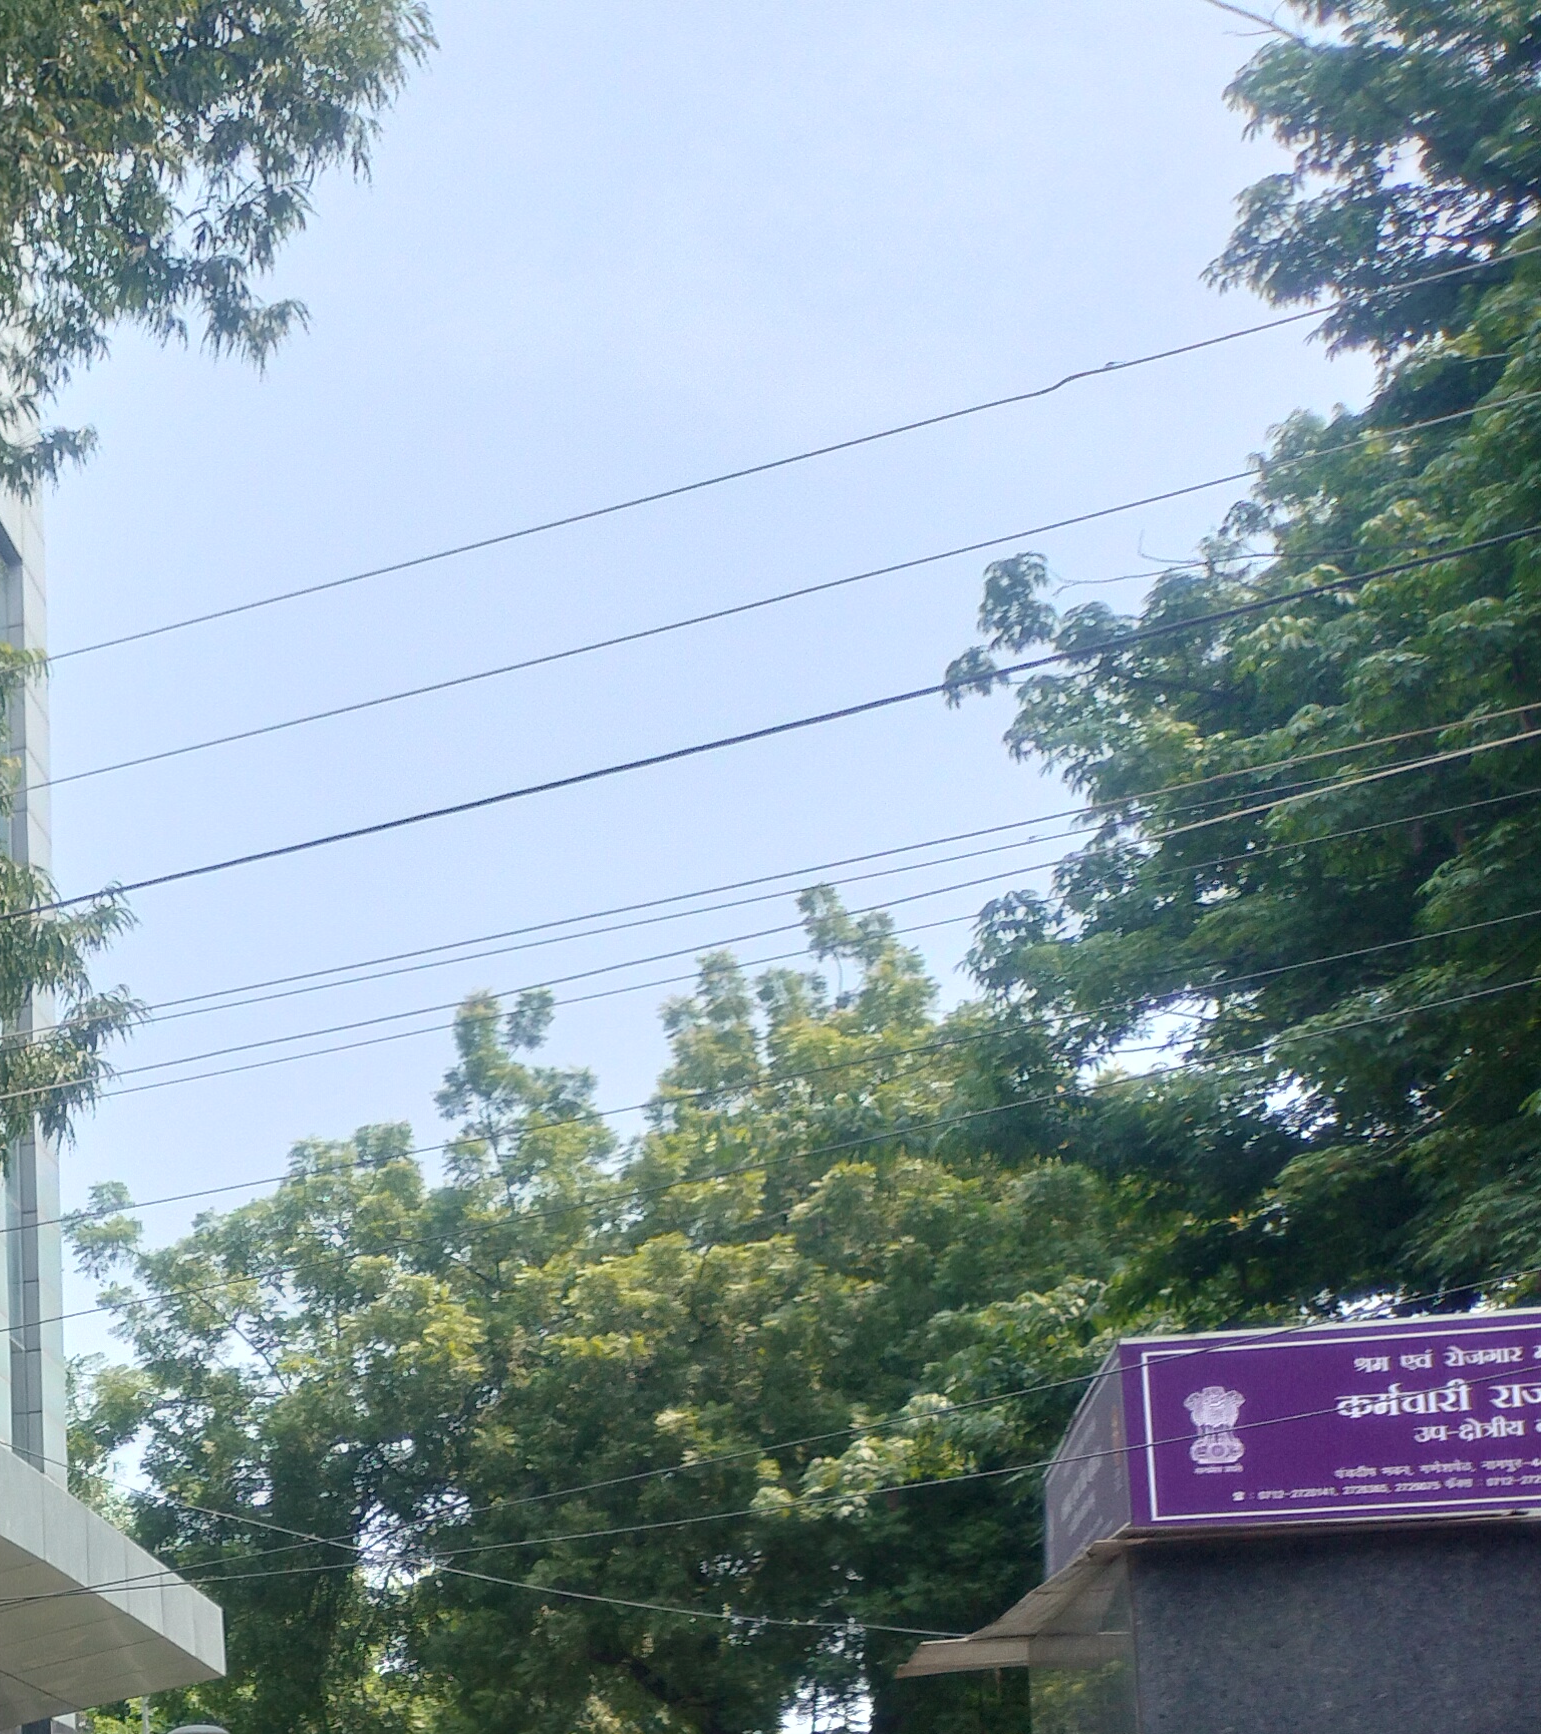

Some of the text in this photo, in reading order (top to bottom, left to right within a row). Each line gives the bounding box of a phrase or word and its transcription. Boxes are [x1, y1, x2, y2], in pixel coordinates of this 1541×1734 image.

[1354, 1346, 1523, 1373] श्रम एवं रोजगार
[1334, 1378, 1473, 1418] कर्मचारी
